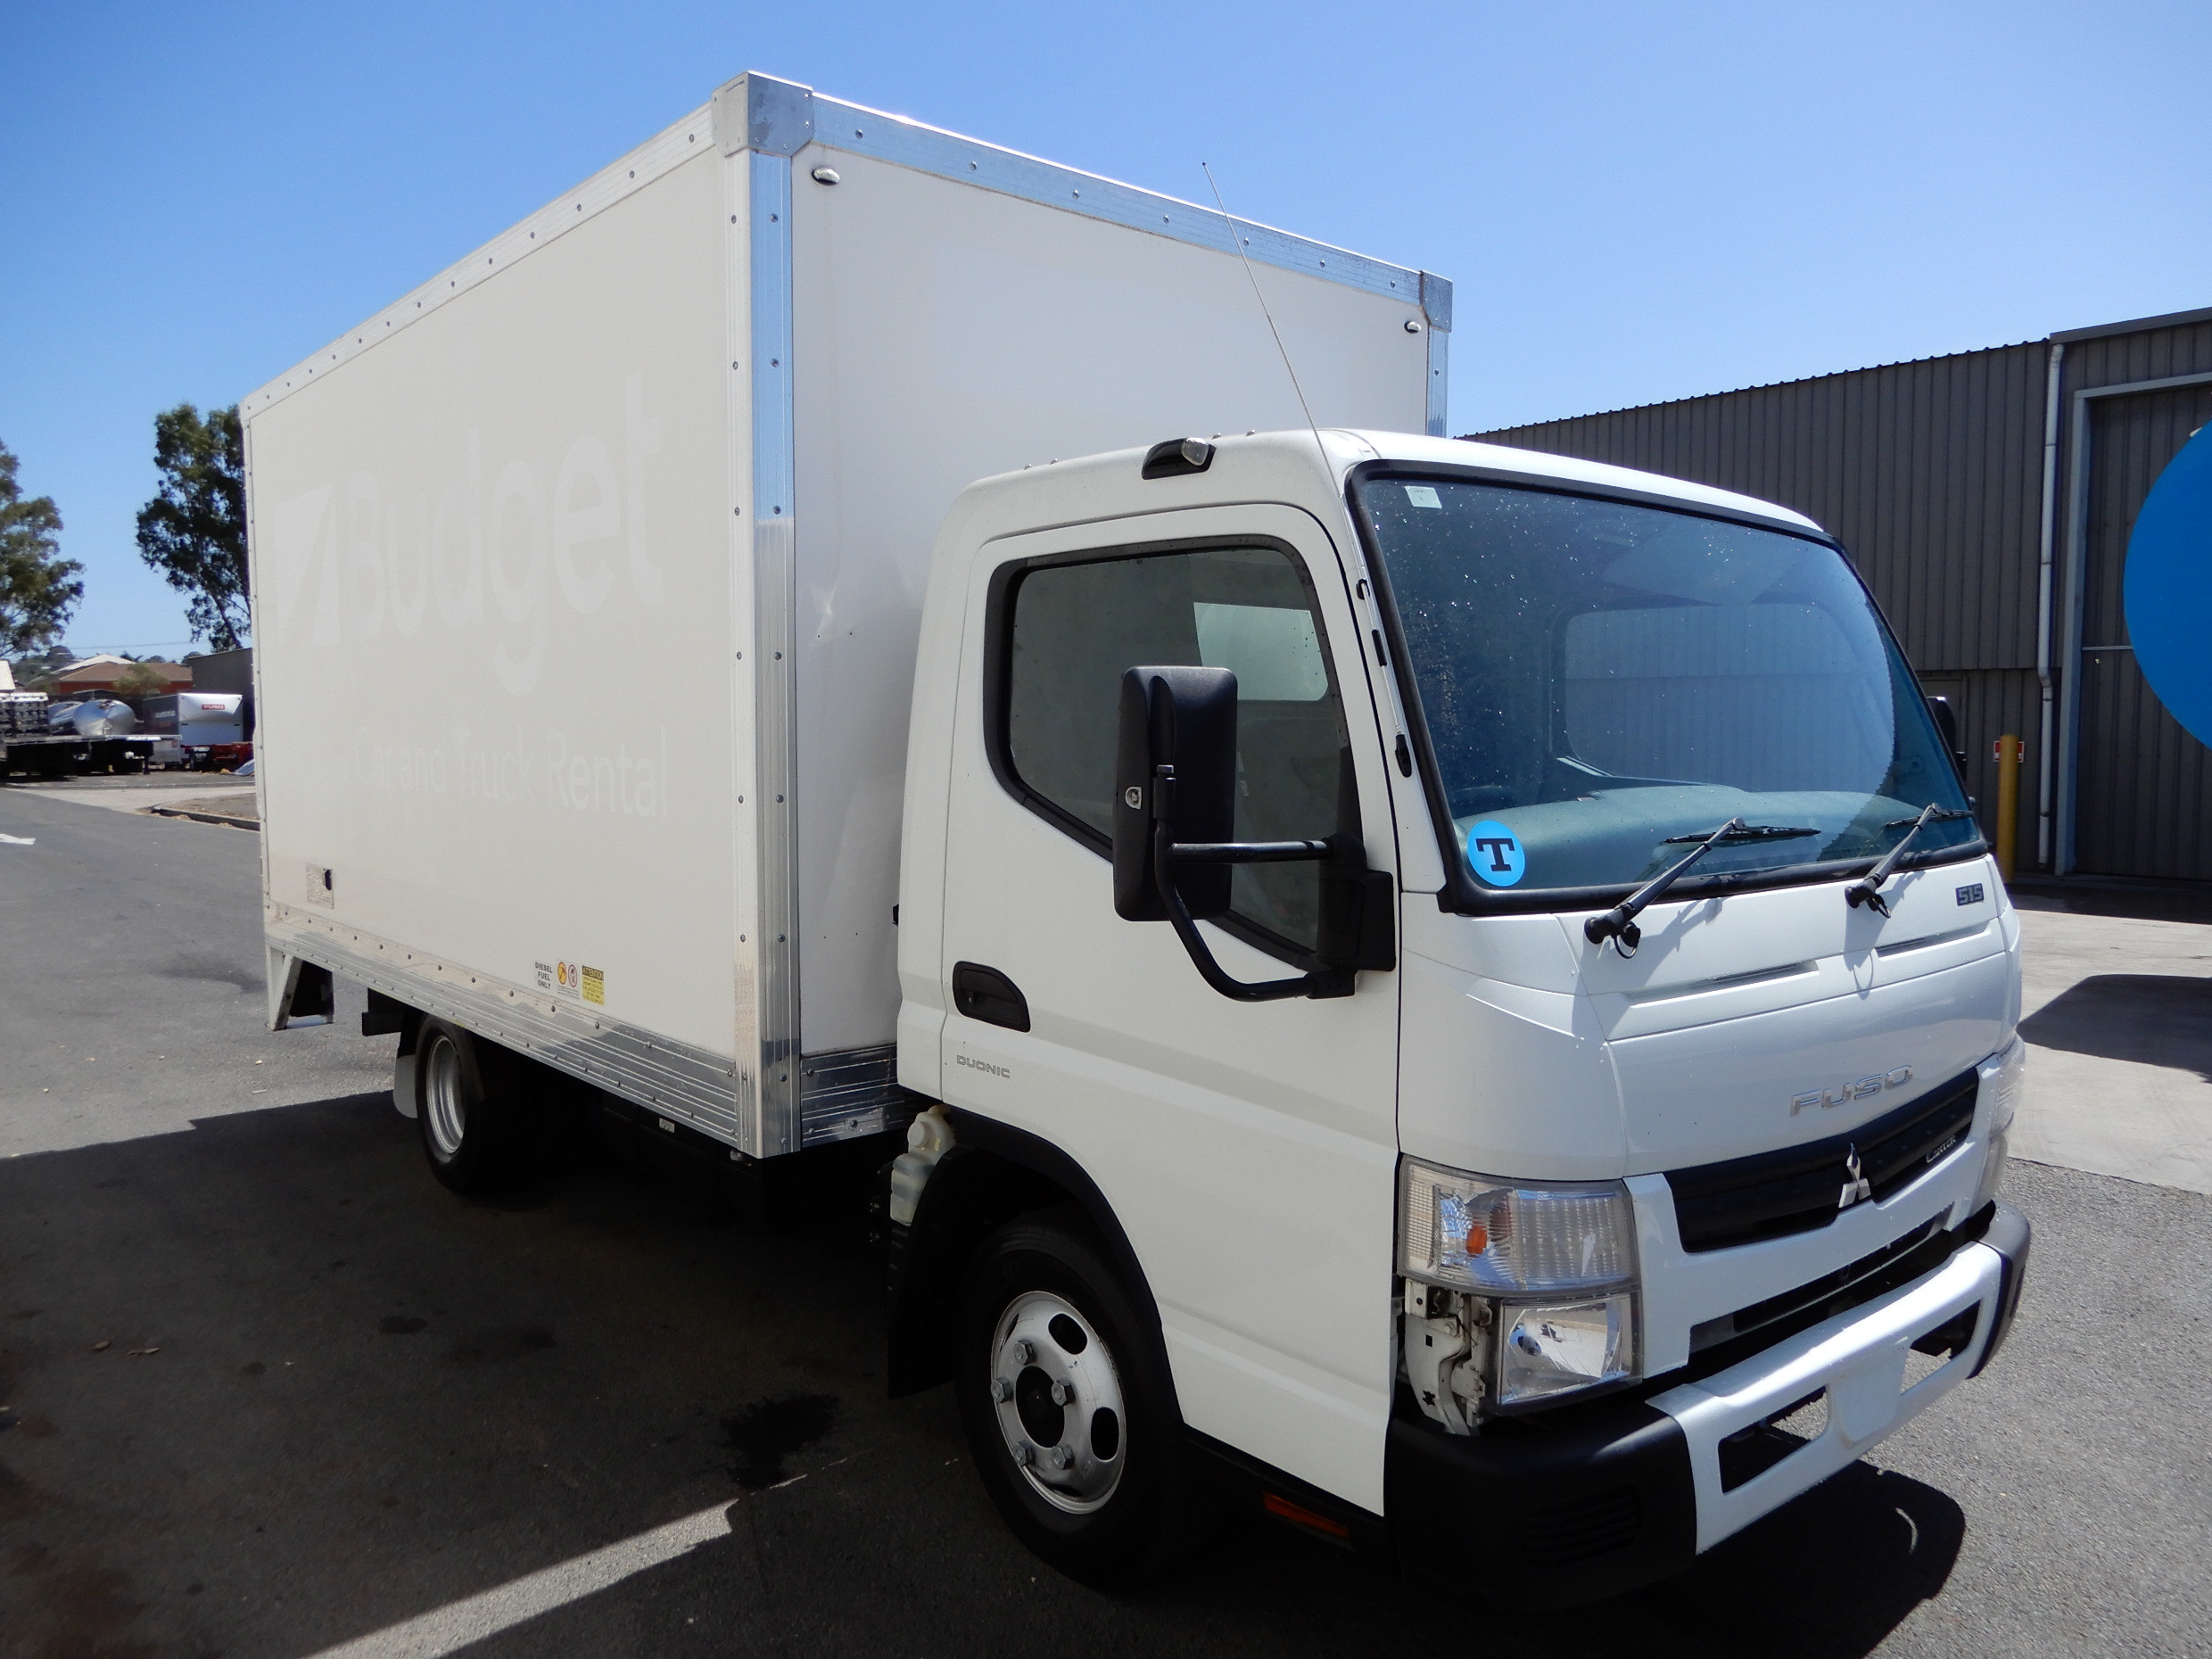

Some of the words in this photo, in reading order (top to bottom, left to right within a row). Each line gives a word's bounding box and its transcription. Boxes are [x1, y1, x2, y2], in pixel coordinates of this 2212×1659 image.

[346, 372, 664, 697] Budget
[450, 724, 537, 802] Truck
[547, 725, 667, 818] Rental
[1475, 838, 1515, 871] T
[1958, 884, 1982, 904] 515
[535, 962, 553, 973] DIESEL
[538, 971, 550, 981] FUEL
[538, 980, 551, 989] ONLY
[957, 1054, 1011, 1079] DUONIC
[1790, 1064, 1913, 1117] FUSO
